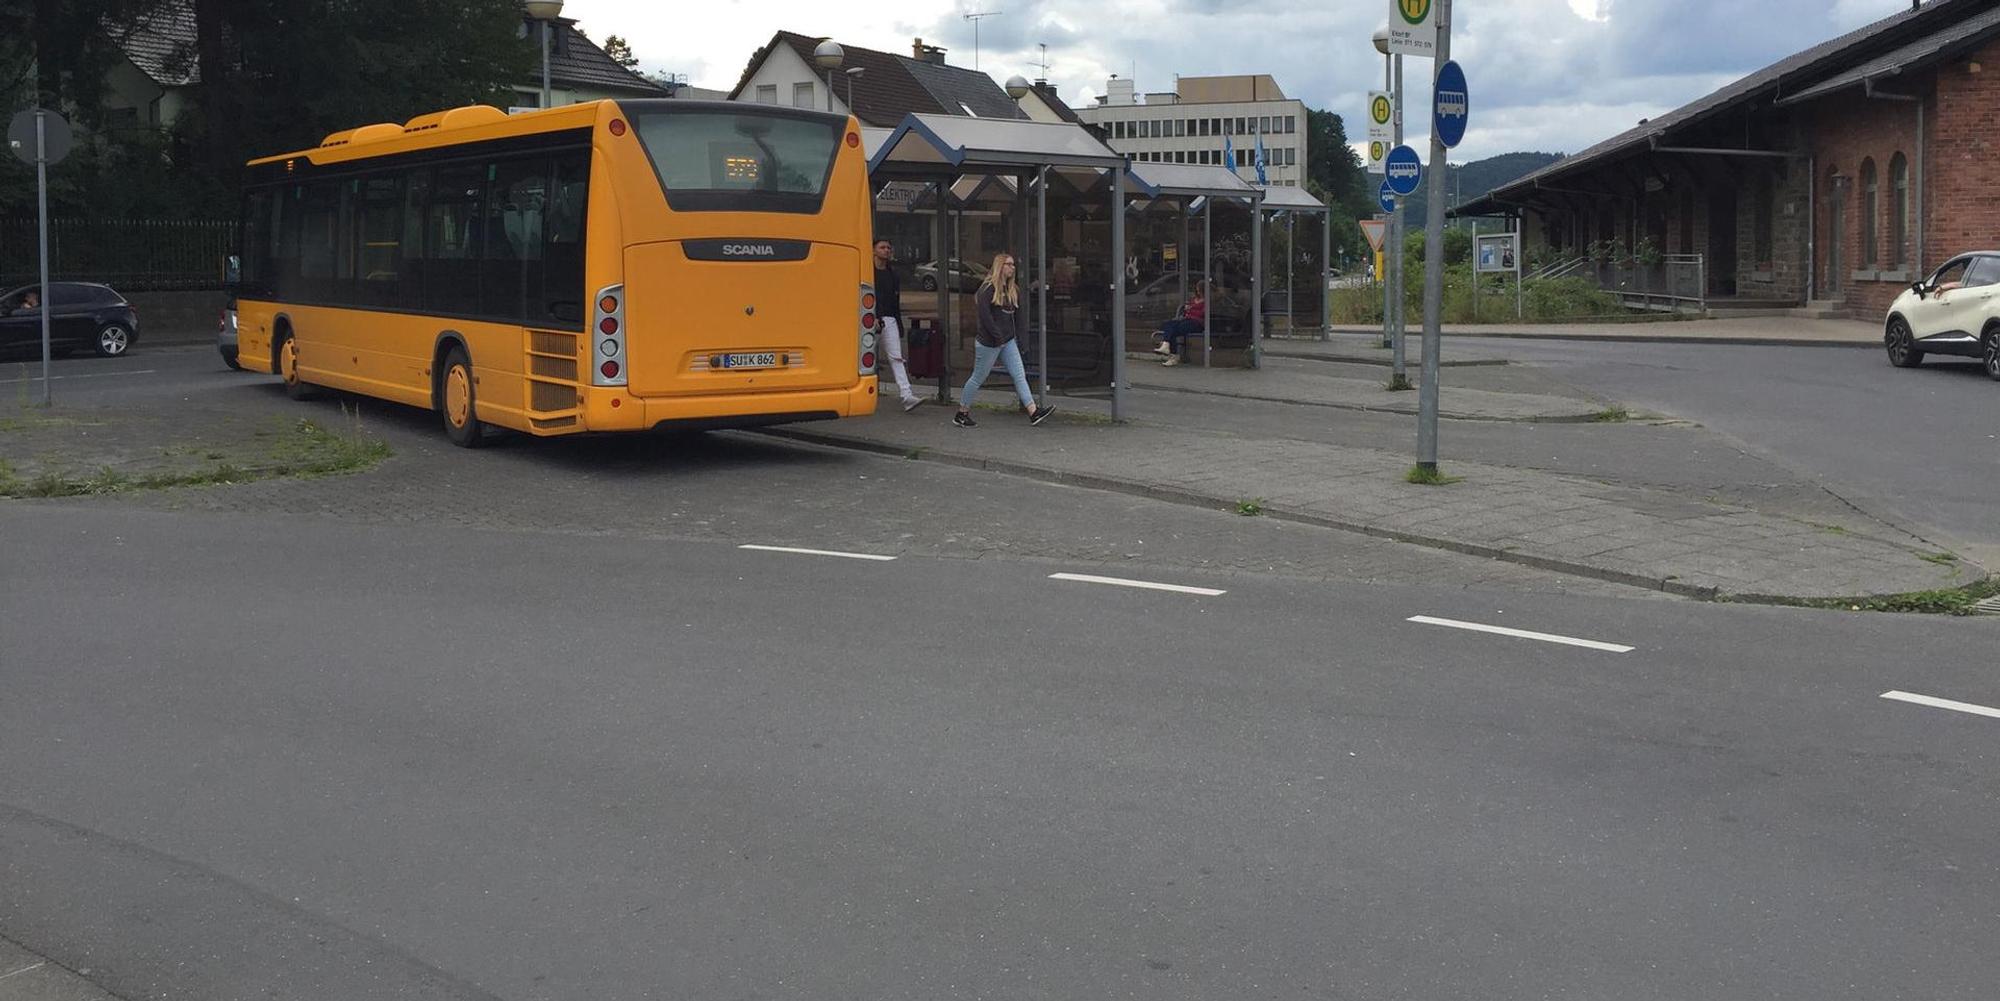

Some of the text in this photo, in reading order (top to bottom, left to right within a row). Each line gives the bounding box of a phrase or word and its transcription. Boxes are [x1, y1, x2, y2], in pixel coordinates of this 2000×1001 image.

[1377, 101, 1386, 117] H
[722, 244, 775, 256] SCANIA
[730, 355, 743, 366] SU
[757, 354, 775, 365] 862
